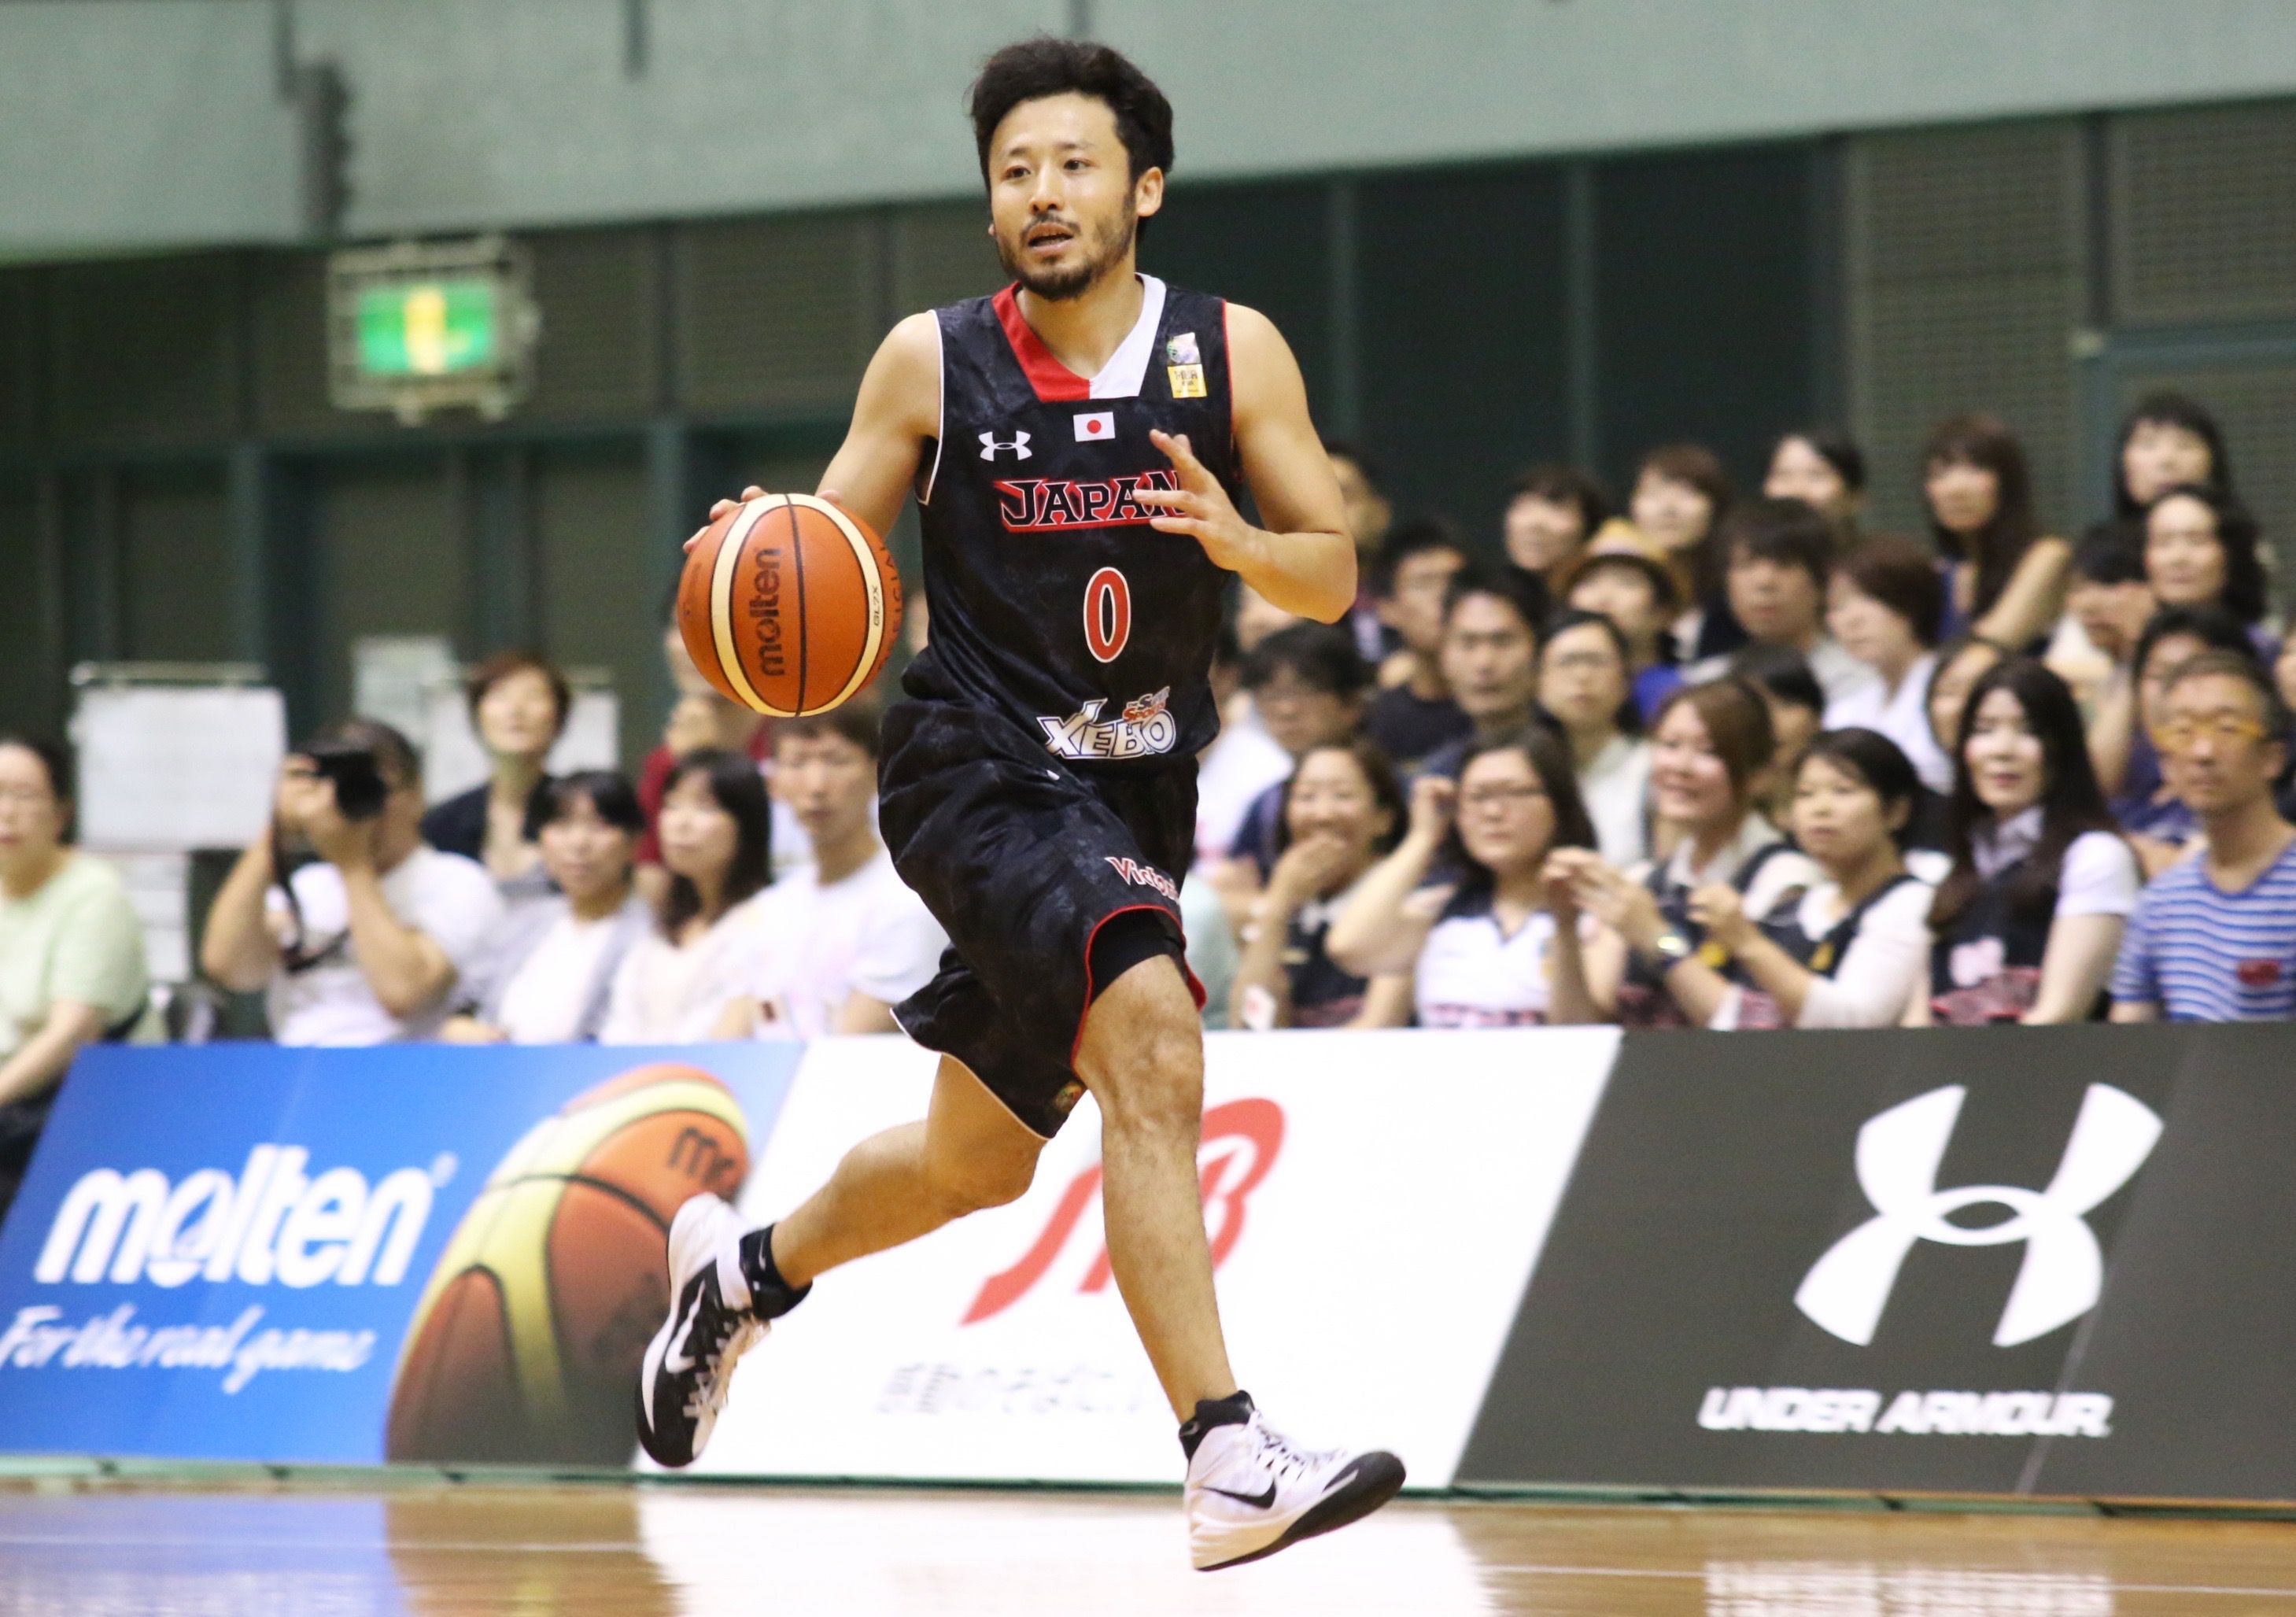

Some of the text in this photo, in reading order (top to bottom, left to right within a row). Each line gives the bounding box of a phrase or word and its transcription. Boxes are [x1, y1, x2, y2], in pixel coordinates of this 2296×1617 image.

[749, 548, 785, 677] molten
[1083, 567, 1131, 663] 0
[33, 1143, 435, 1288] molten
[1698, 1386, 2114, 1438] UNDER ARMOUR
